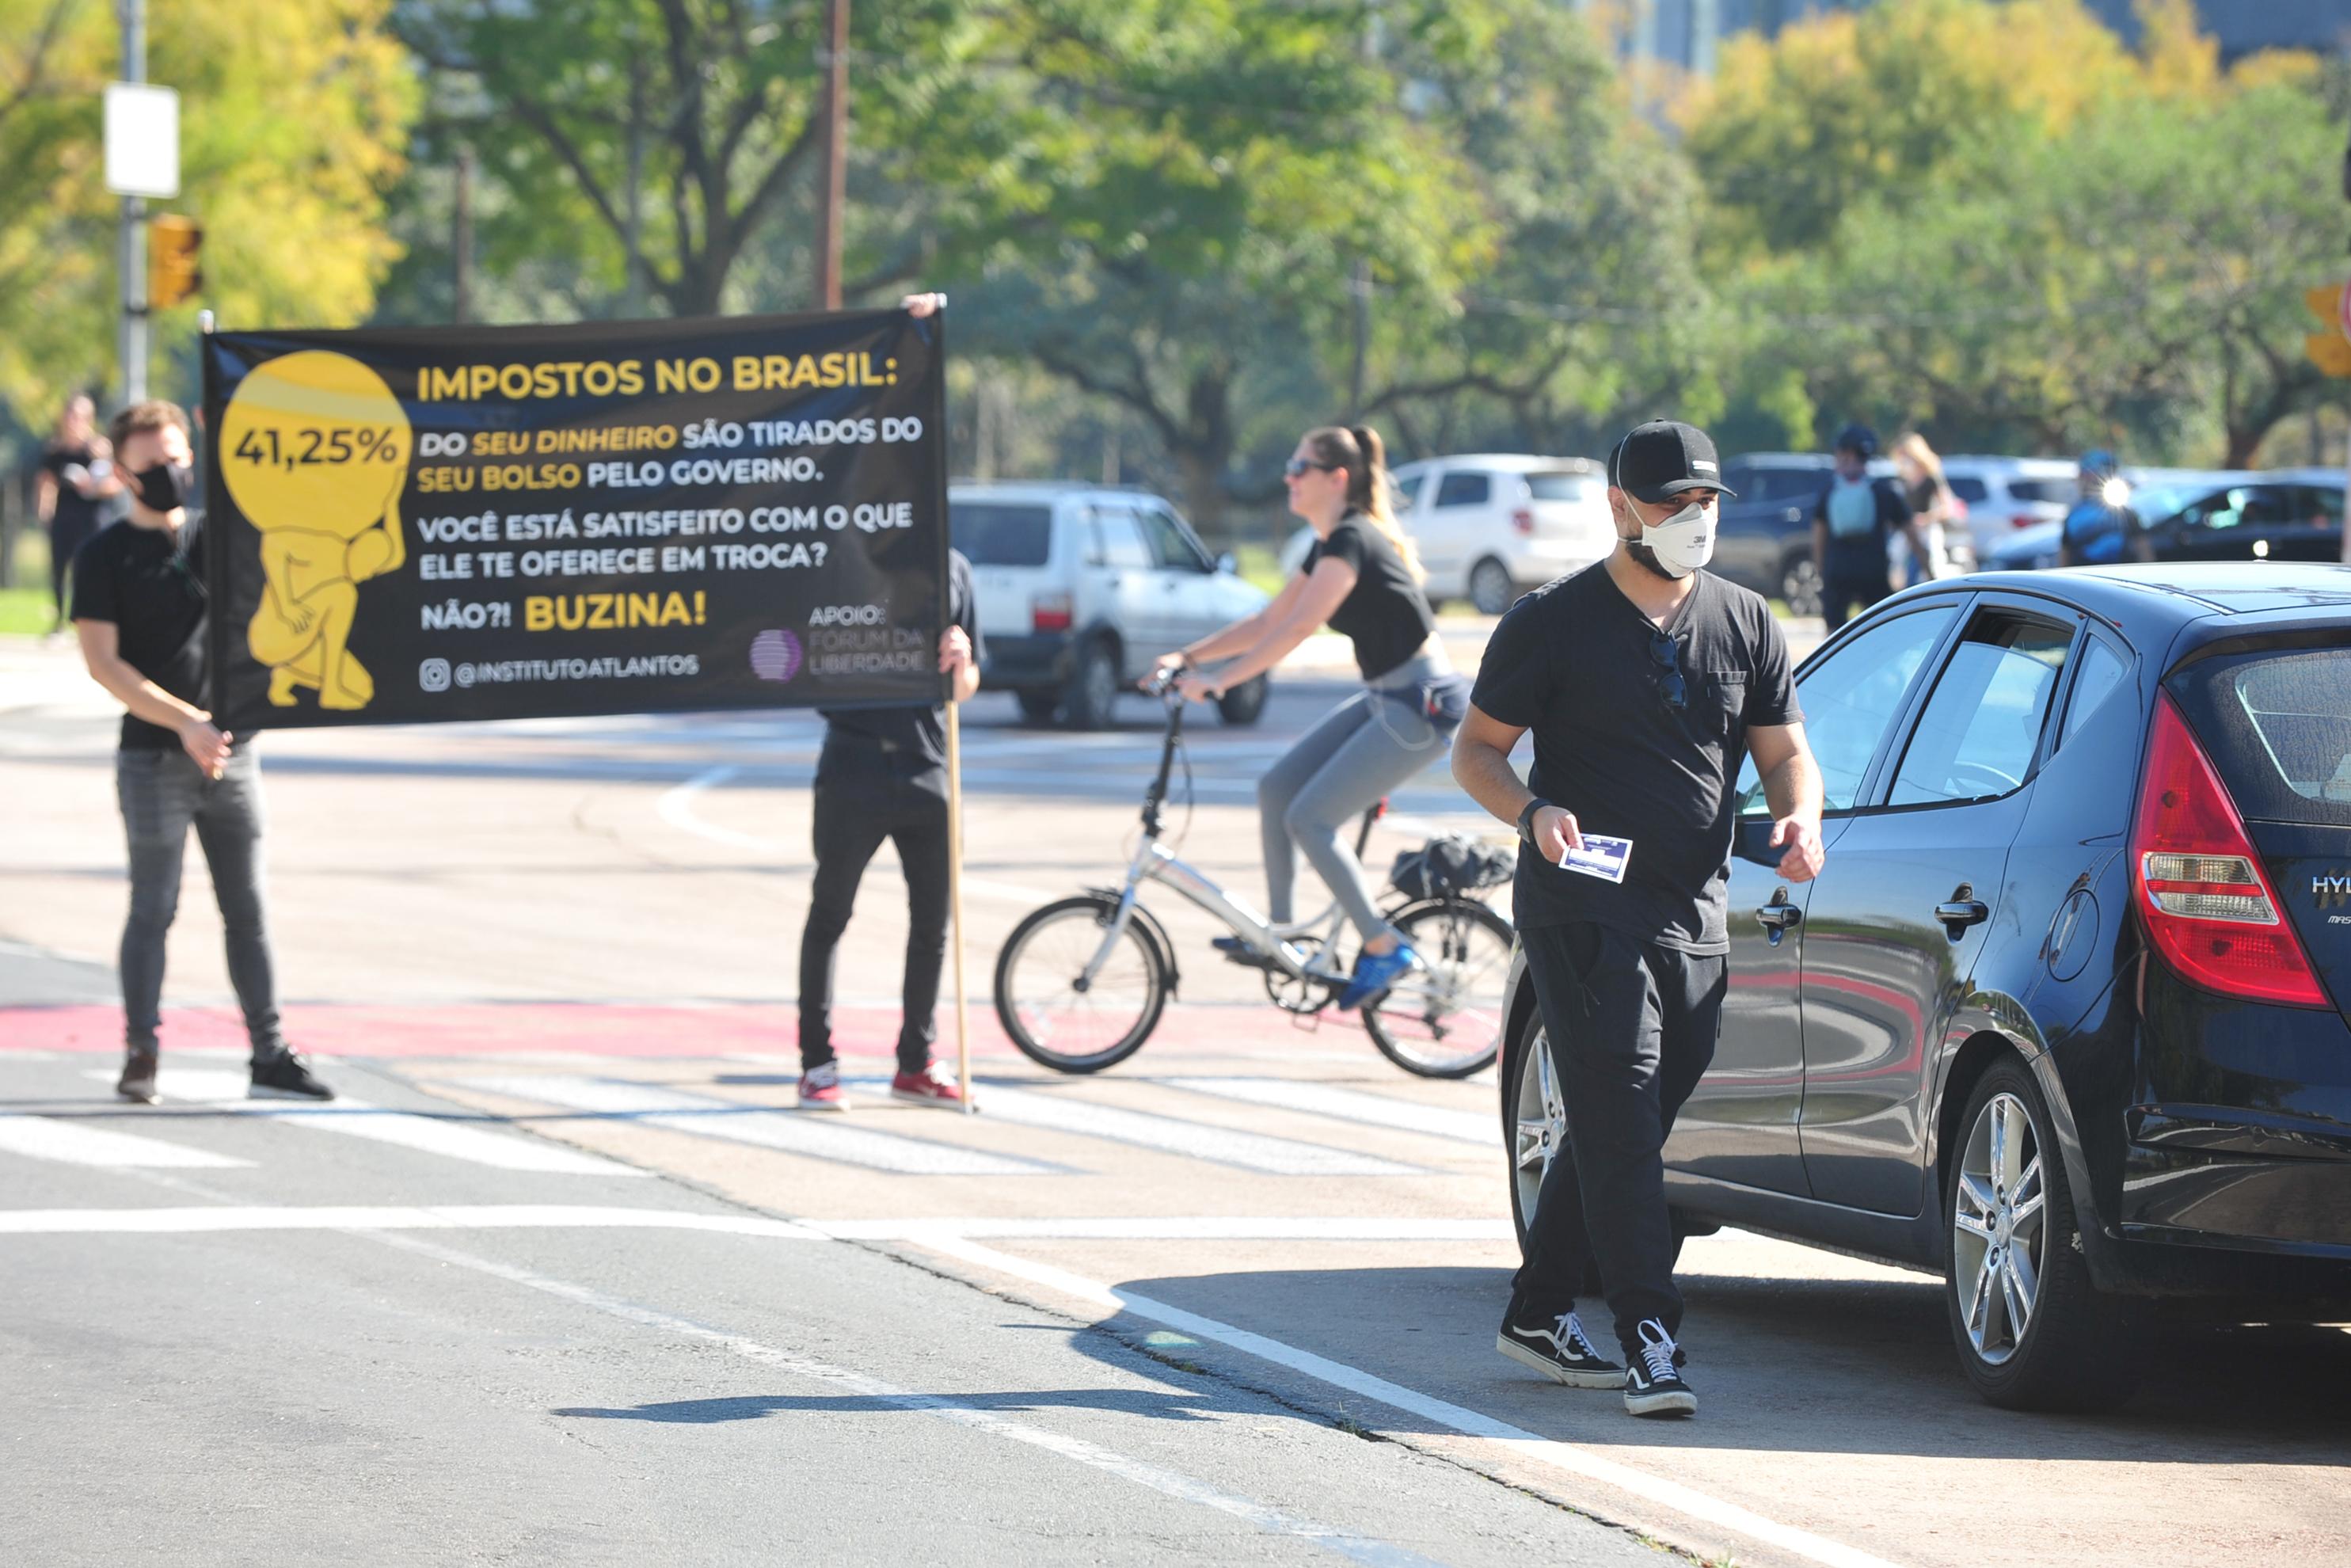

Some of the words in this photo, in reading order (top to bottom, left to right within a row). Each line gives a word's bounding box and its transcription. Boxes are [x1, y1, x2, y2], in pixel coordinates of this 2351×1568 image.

[417, 360, 645, 401] IMPOSTOS
[655, 357, 721, 394] NO
[732, 352, 898, 391] BRASIL:
[235, 428, 398, 473] 41,25%
[419, 432, 467, 457] DO
[471, 431, 529, 455] SEU
[535, 424, 677, 453] DINHEIRO
[683, 417, 744, 448] SÃO
[748, 418, 877, 447] TIRADOS
[881, 417, 923, 443] DO
[417, 466, 474, 493] SEU
[481, 462, 581, 491] BOLSO
[588, 461, 664, 487] PELO
[670, 456, 824, 485] GOVERNO.
[417, 510, 500, 543] VOCÊ
[505, 508, 578, 541] ESTÁ
[583, 508, 745, 539] SATISFEITO
[749, 504, 818, 532] COM
[824, 504, 850, 530] O
[853, 502, 913, 532] QUE
[419, 554, 473, 580] ELE
[477, 551, 514, 578] TE
[519, 546, 656, 577] OFERECE
[661, 546, 706, 573] EM
[711, 541, 828, 570] TROCA?
[420, 598, 512, 630] NÃO?!
[524, 589, 707, 631] BUZINA!
[808, 604, 886, 627] APOIO:
[454, 655, 700, 687] @INSTITUTOATLANTOS
[808, 649, 926, 676] LIBERDADE
